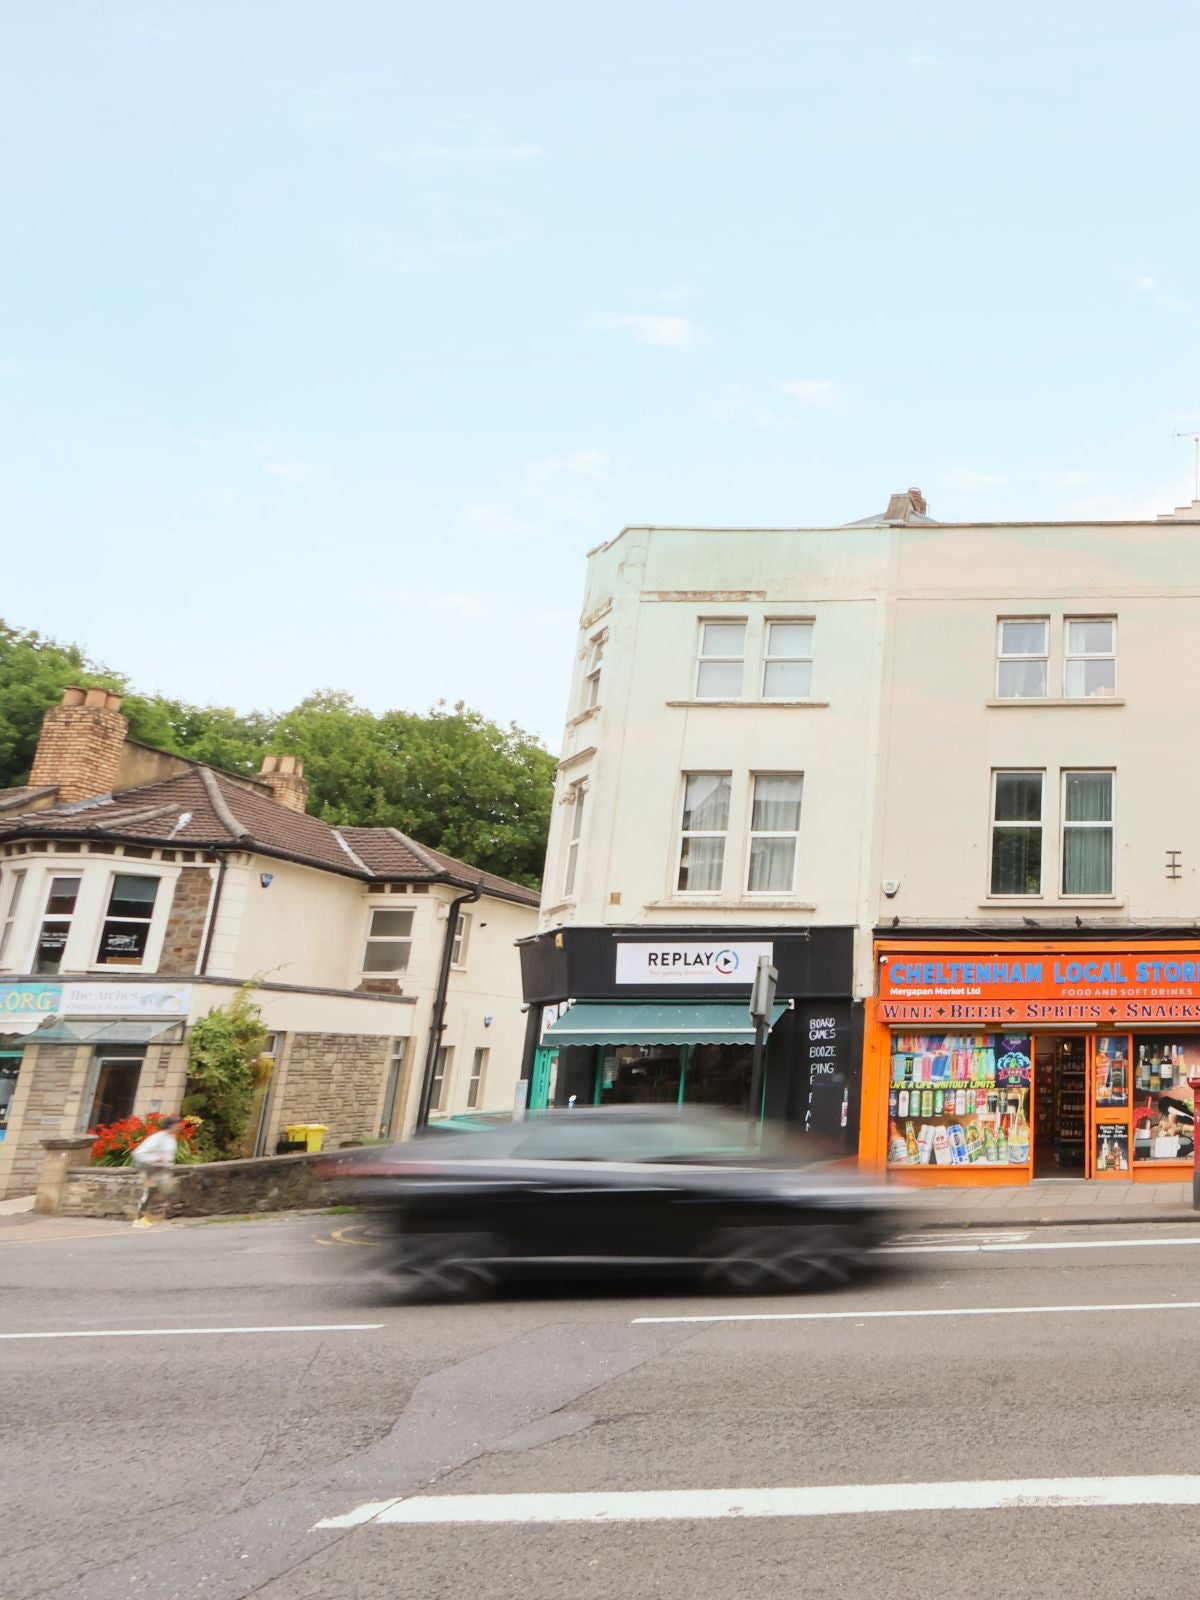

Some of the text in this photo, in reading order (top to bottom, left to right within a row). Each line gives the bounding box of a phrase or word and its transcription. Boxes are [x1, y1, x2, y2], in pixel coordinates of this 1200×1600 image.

[648, 951, 714, 967] REPLAY
[889, 962, 1043, 985] CHELTENHAM
[1053, 961, 1128, 984] LOCAL
[71, 990, 138, 1000] The Arches
[889, 987, 981, 997] Mergapan Market Ltd
[1061, 988, 1193, 996] FOOD AND SOFT DRINKS
[884, 1004, 932, 1018] WINE
[951, 1004, 1001, 1017] BEER
[1027, 1003, 1101, 1017] SPRITS
[809, 1018, 835, 1029] BOARD
[809, 1028, 836, 1041] GAMES
[809, 1046, 836, 1058] BOOZE
[810, 1063, 834, 1074] PING
[970, 1080, 996, 1088] LIMITS
